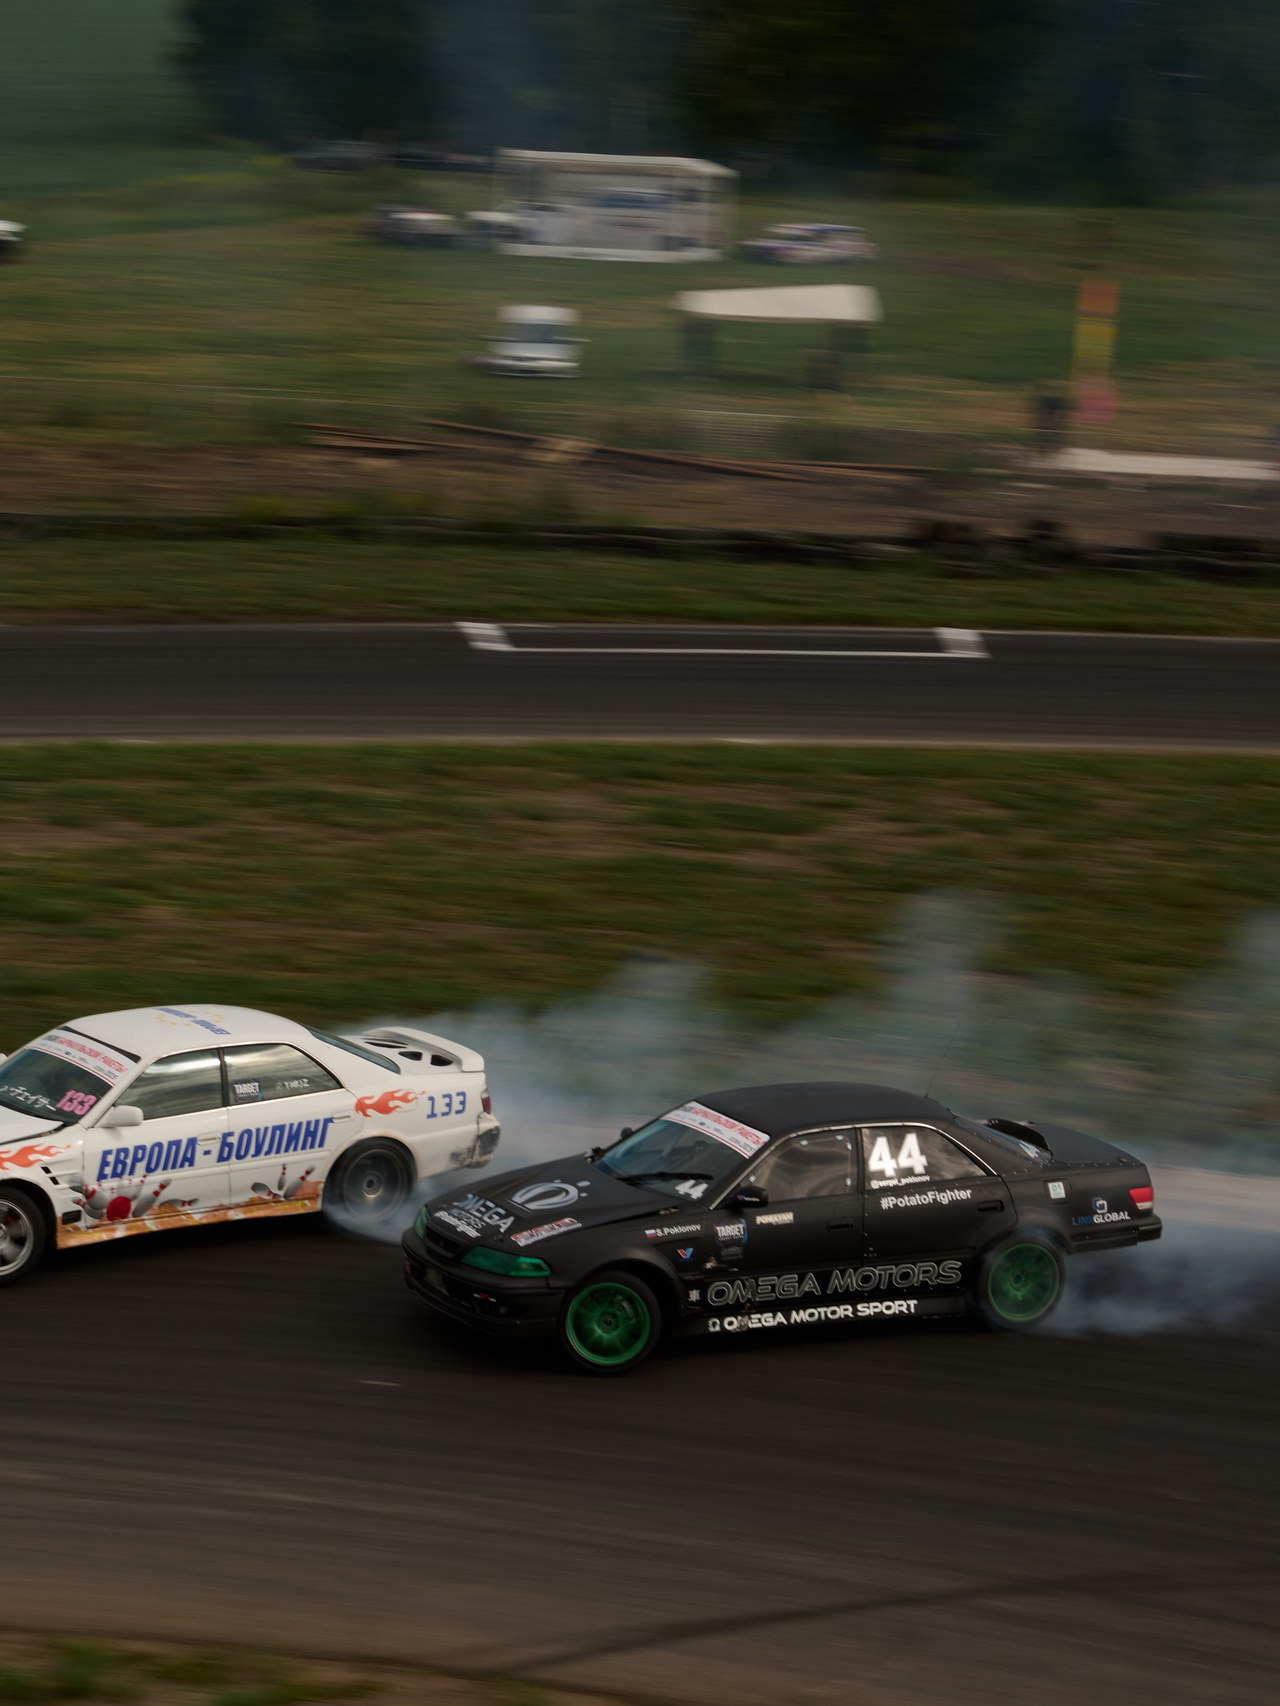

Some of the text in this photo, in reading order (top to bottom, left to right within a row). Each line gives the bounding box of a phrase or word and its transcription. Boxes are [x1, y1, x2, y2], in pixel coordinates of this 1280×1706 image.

[233, 1082, 260, 1095] TARGET
[56, 1089, 98, 1116] 133
[426, 1091, 467, 1119] 133
[97, 1137, 198, 1182] ЕВРОПА
[217, 1117, 334, 1163] БОУЛИНГ
[868, 1132, 928, 1178] 44
[674, 1179, 709, 1200] 44
[880, 1189, 972, 1210] #PotatoFighter
[656, 1224, 702, 1238] S.Poklonov
[715, 1223, 745, 1238] TARGET
[706, 1260, 962, 1306] OMEGA MOTORS
[790, 1304, 854, 1325] MOTOR
[856, 1300, 918, 1317] SPORT
